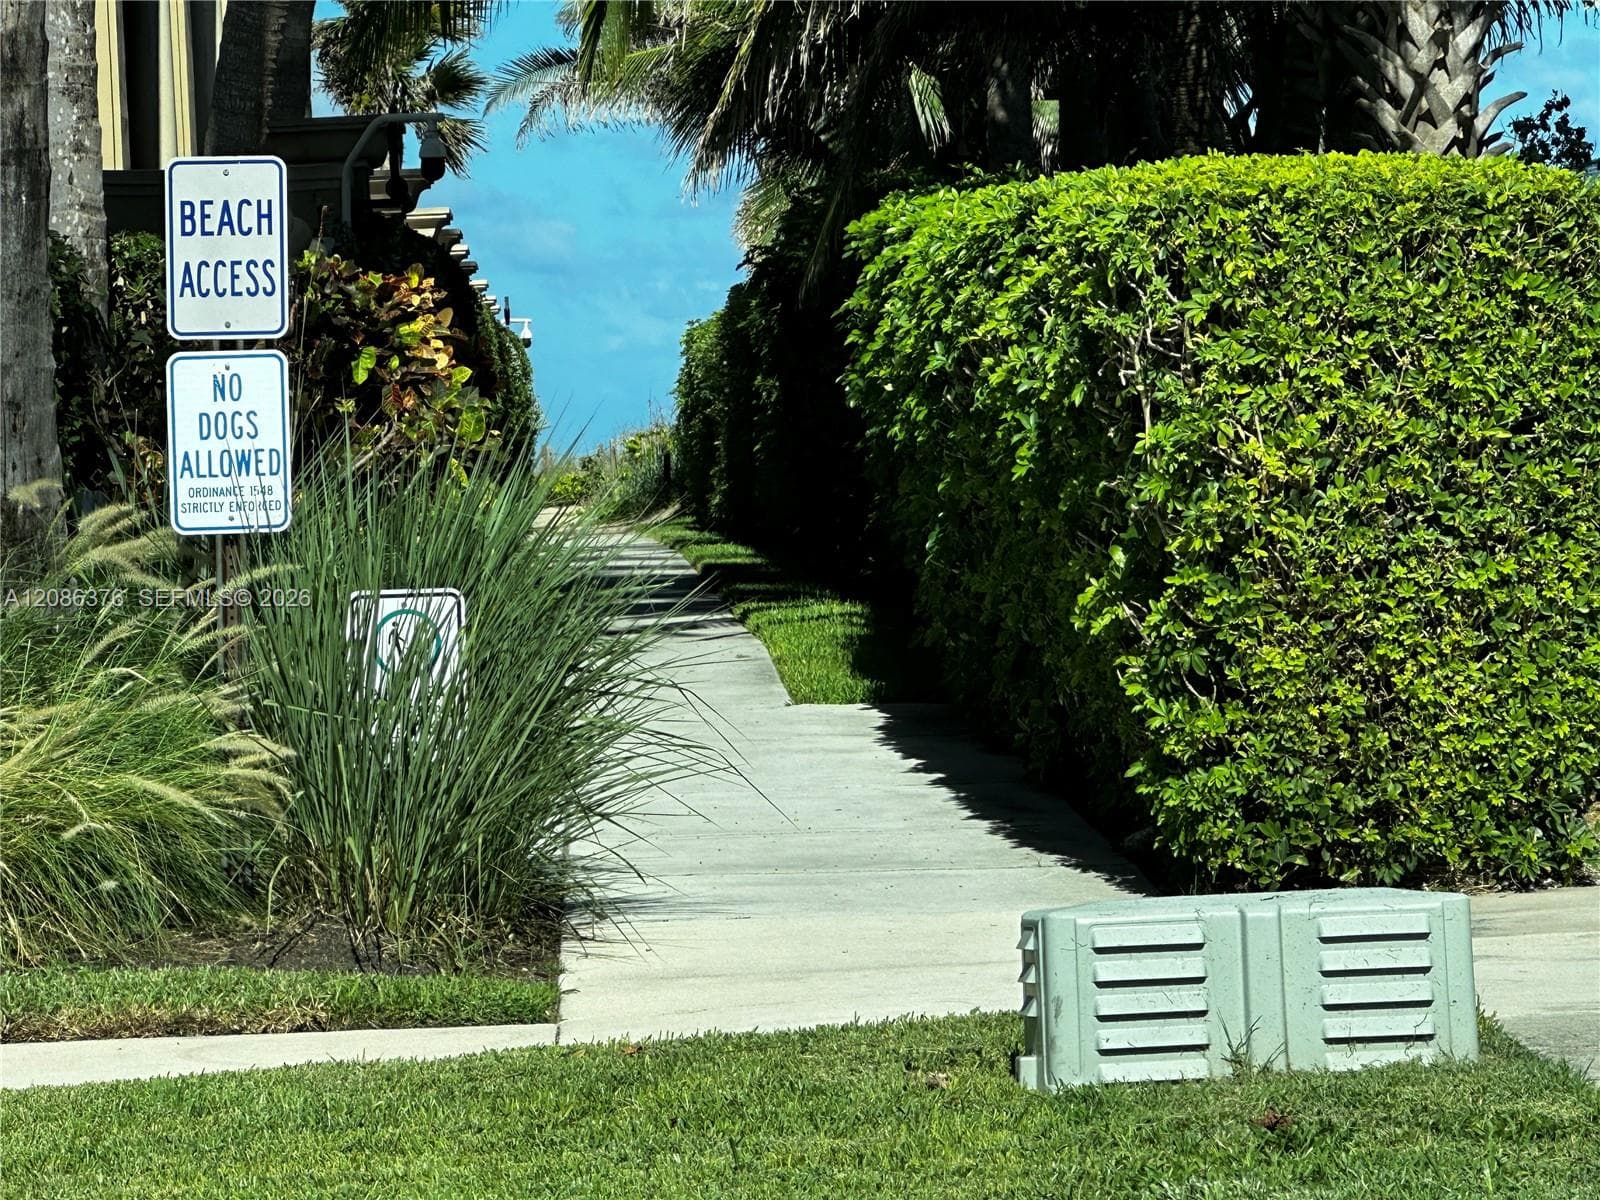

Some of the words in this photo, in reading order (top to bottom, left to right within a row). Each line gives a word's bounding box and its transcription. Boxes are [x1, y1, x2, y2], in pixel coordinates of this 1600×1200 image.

[180, 199, 273, 237] BEACH
[179, 259, 277, 298] ACCESS
[212, 372, 242, 403] NO
[199, 410, 259, 441] DOGS
[179, 448, 281, 479] ALLOWED
[180, 501, 224, 514] STRICTLY
[229, 499, 282, 513] ENFORCED
[188, 486, 245, 499] ORDINANCE
[250, 484, 274, 497] 1548
